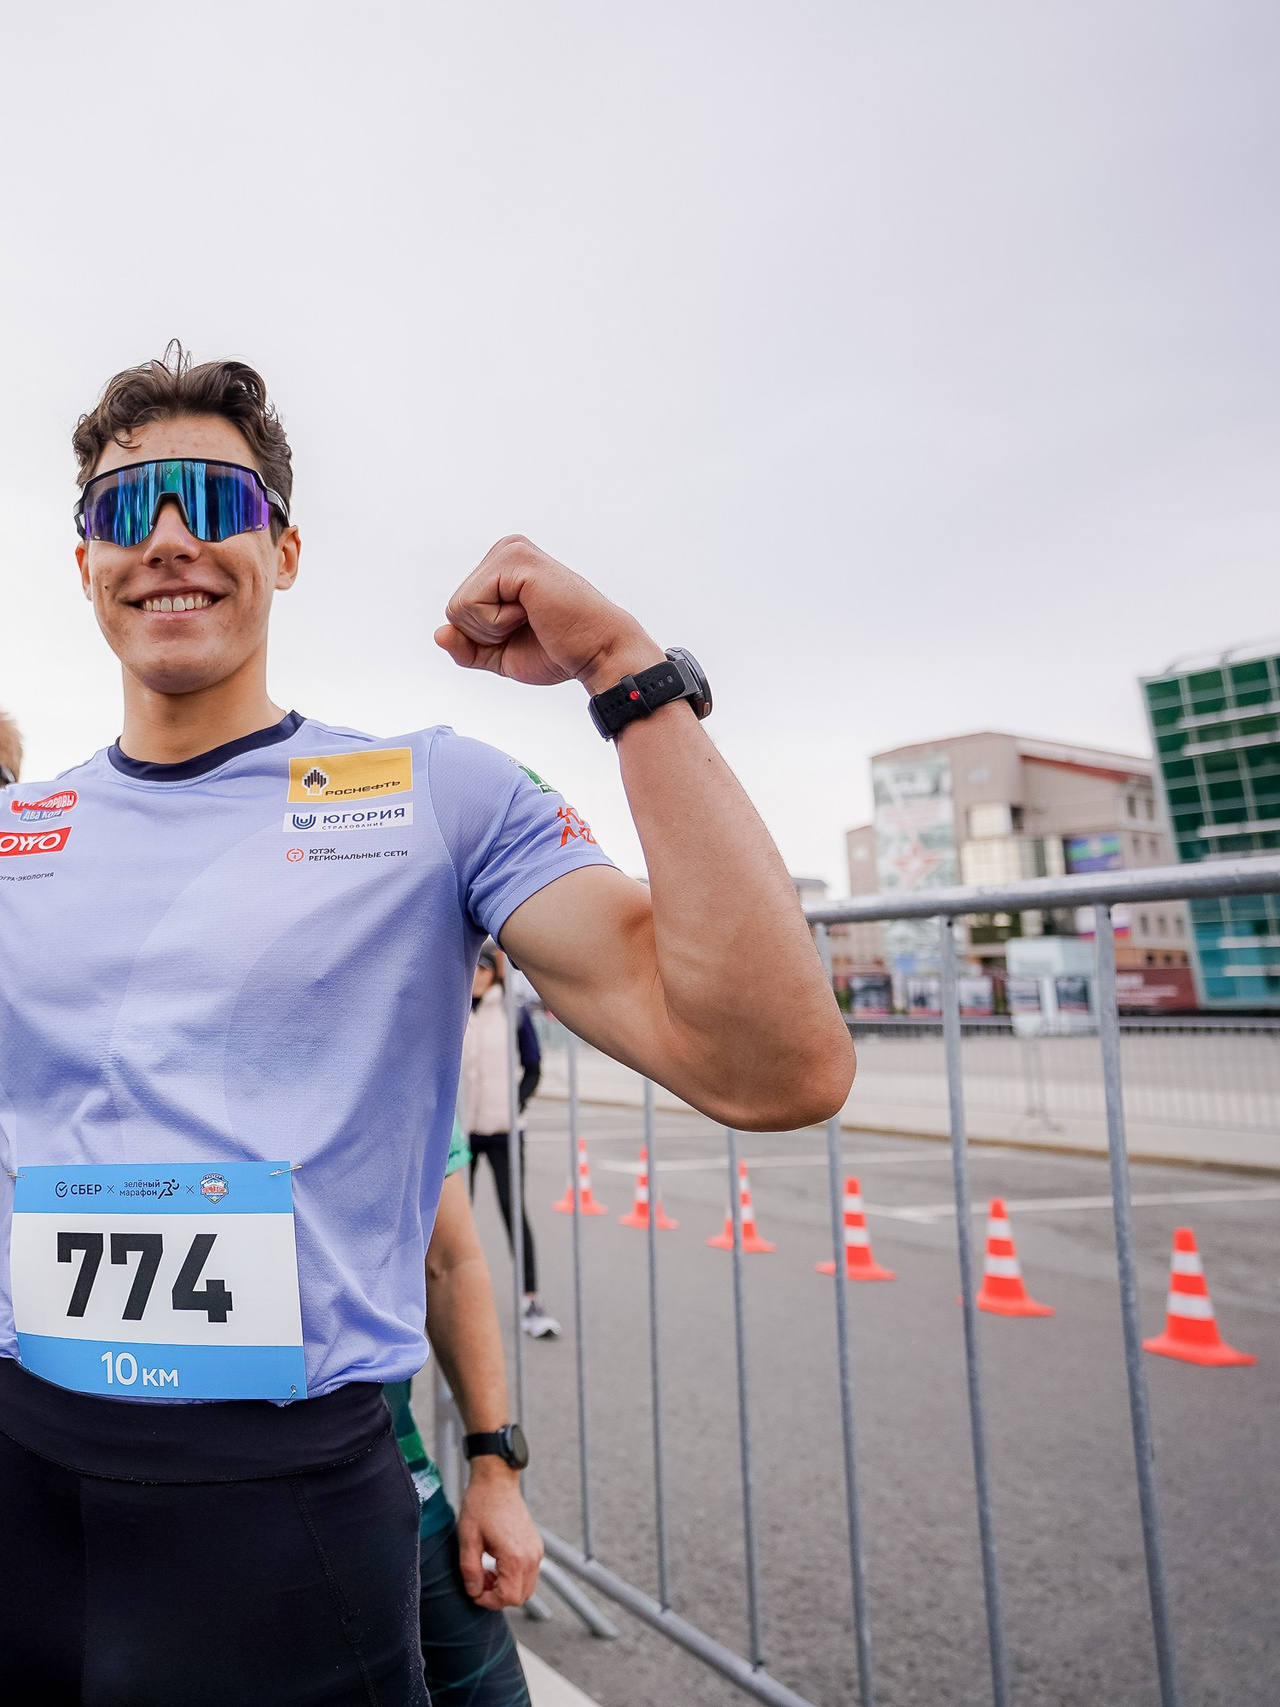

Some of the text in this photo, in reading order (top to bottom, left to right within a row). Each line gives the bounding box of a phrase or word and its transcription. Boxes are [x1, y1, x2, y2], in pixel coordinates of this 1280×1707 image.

[324, 780, 401, 796] РОСНЕФТЬ
[322, 807, 405, 824] ЮГОРИЯ
[321, 821, 384, 831] СТРАХОВАНИЕ
[308, 852, 382, 862] РЕГИОНАЛЬНЫЕ
[123, 1179, 161, 1188] зелёный
[70, 1184, 102, 1195] СБЕР
[119, 1189, 158, 1198] марафон
[56, 1231, 234, 1323] 774
[100, 1351, 138, 1386] 10
